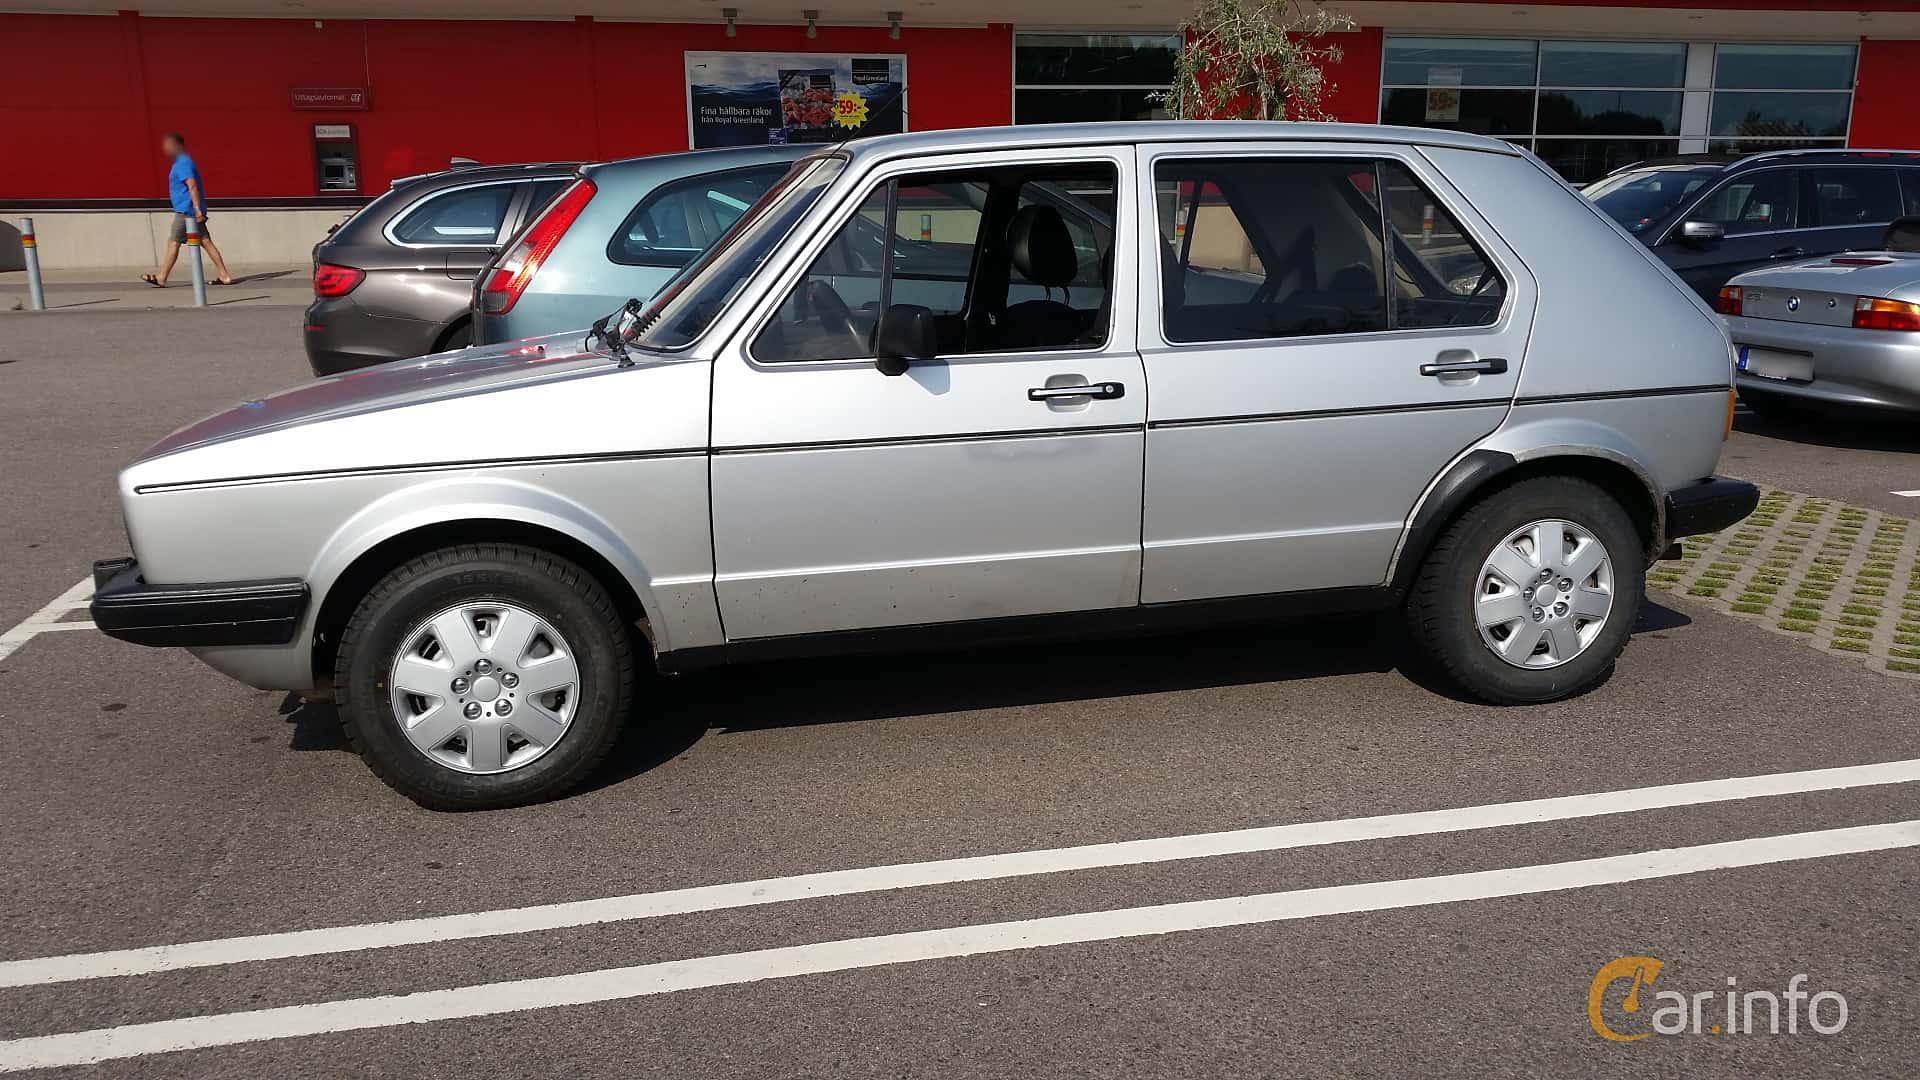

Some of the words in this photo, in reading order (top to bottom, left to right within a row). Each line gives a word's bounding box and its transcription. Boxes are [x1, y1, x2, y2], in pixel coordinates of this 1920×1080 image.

[701, 106, 717, 115] Fina
[719, 106, 751, 116] hållbara
[701, 116, 714, 124] från
[732, 116, 764, 124] Greenland
